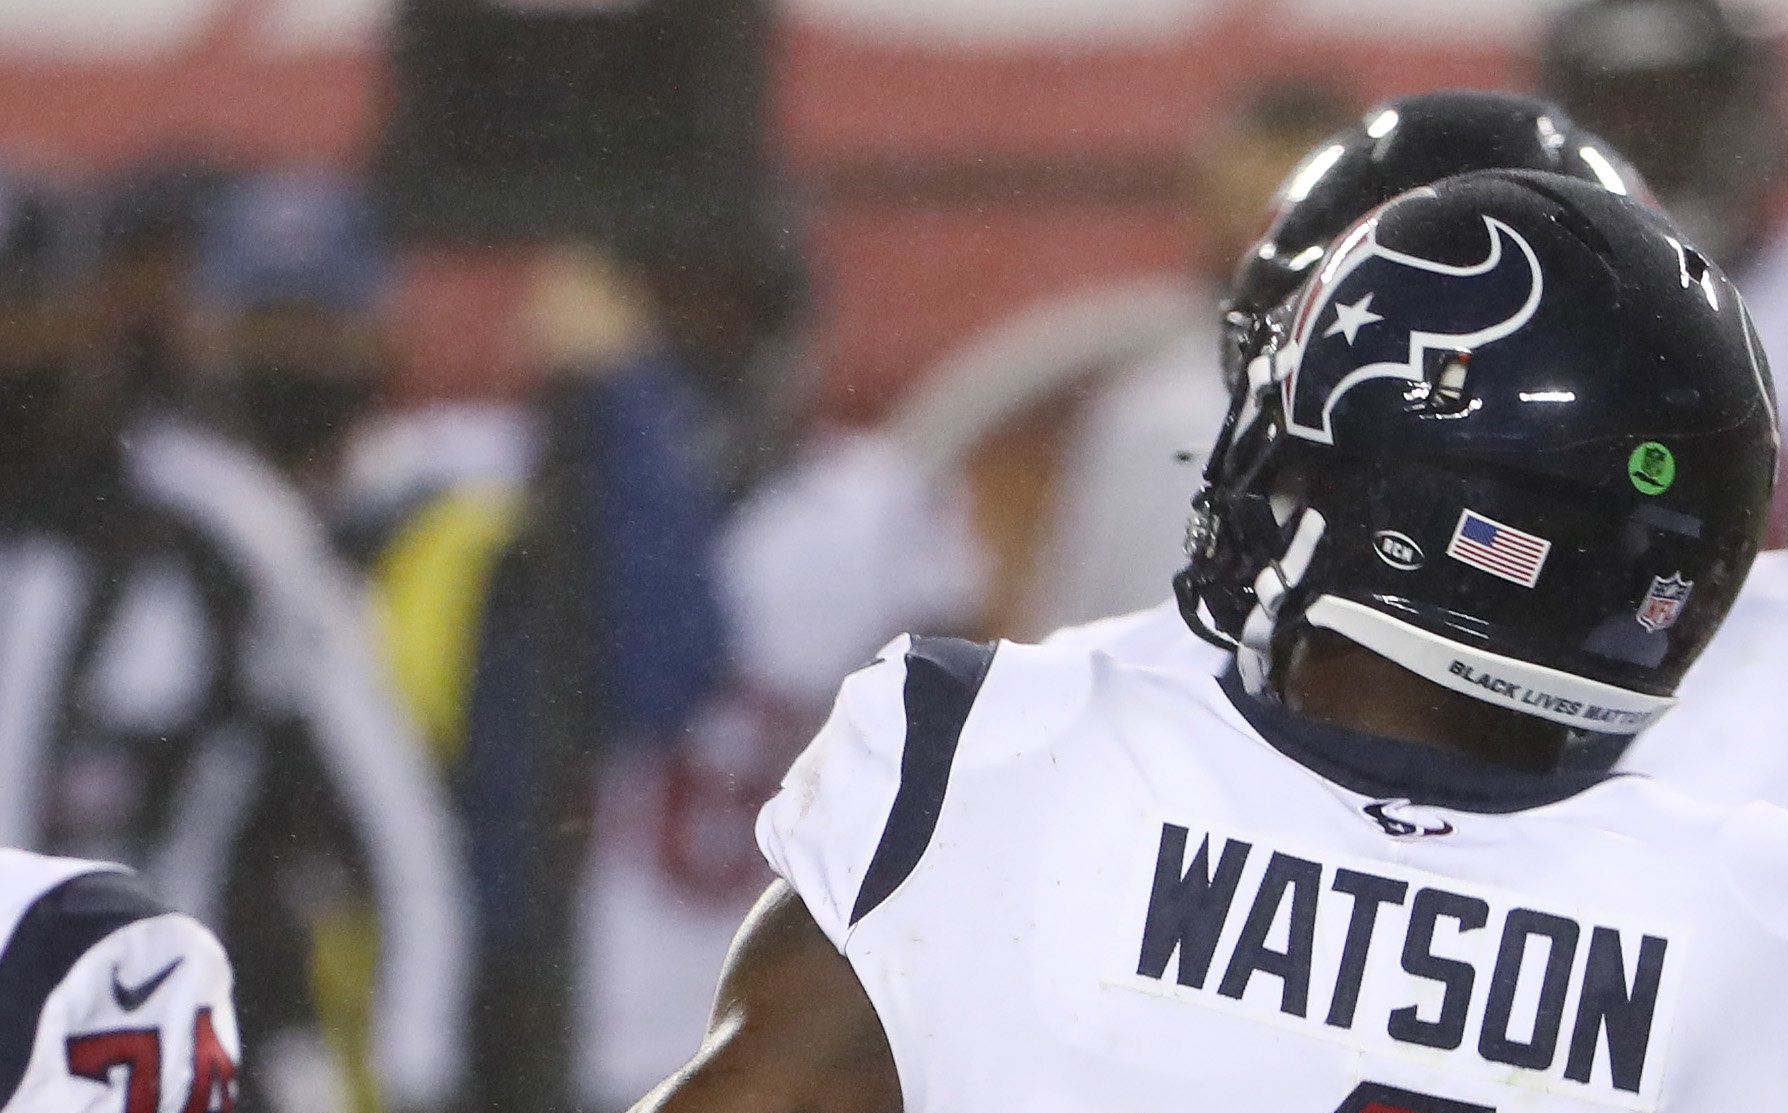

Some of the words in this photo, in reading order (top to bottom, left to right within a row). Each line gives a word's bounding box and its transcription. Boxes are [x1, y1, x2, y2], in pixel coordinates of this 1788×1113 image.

[1449, 659, 1523, 699] BLACK
[1523, 689, 1583, 716] LIVES
[1136, 822, 1668, 1094] WATSON
